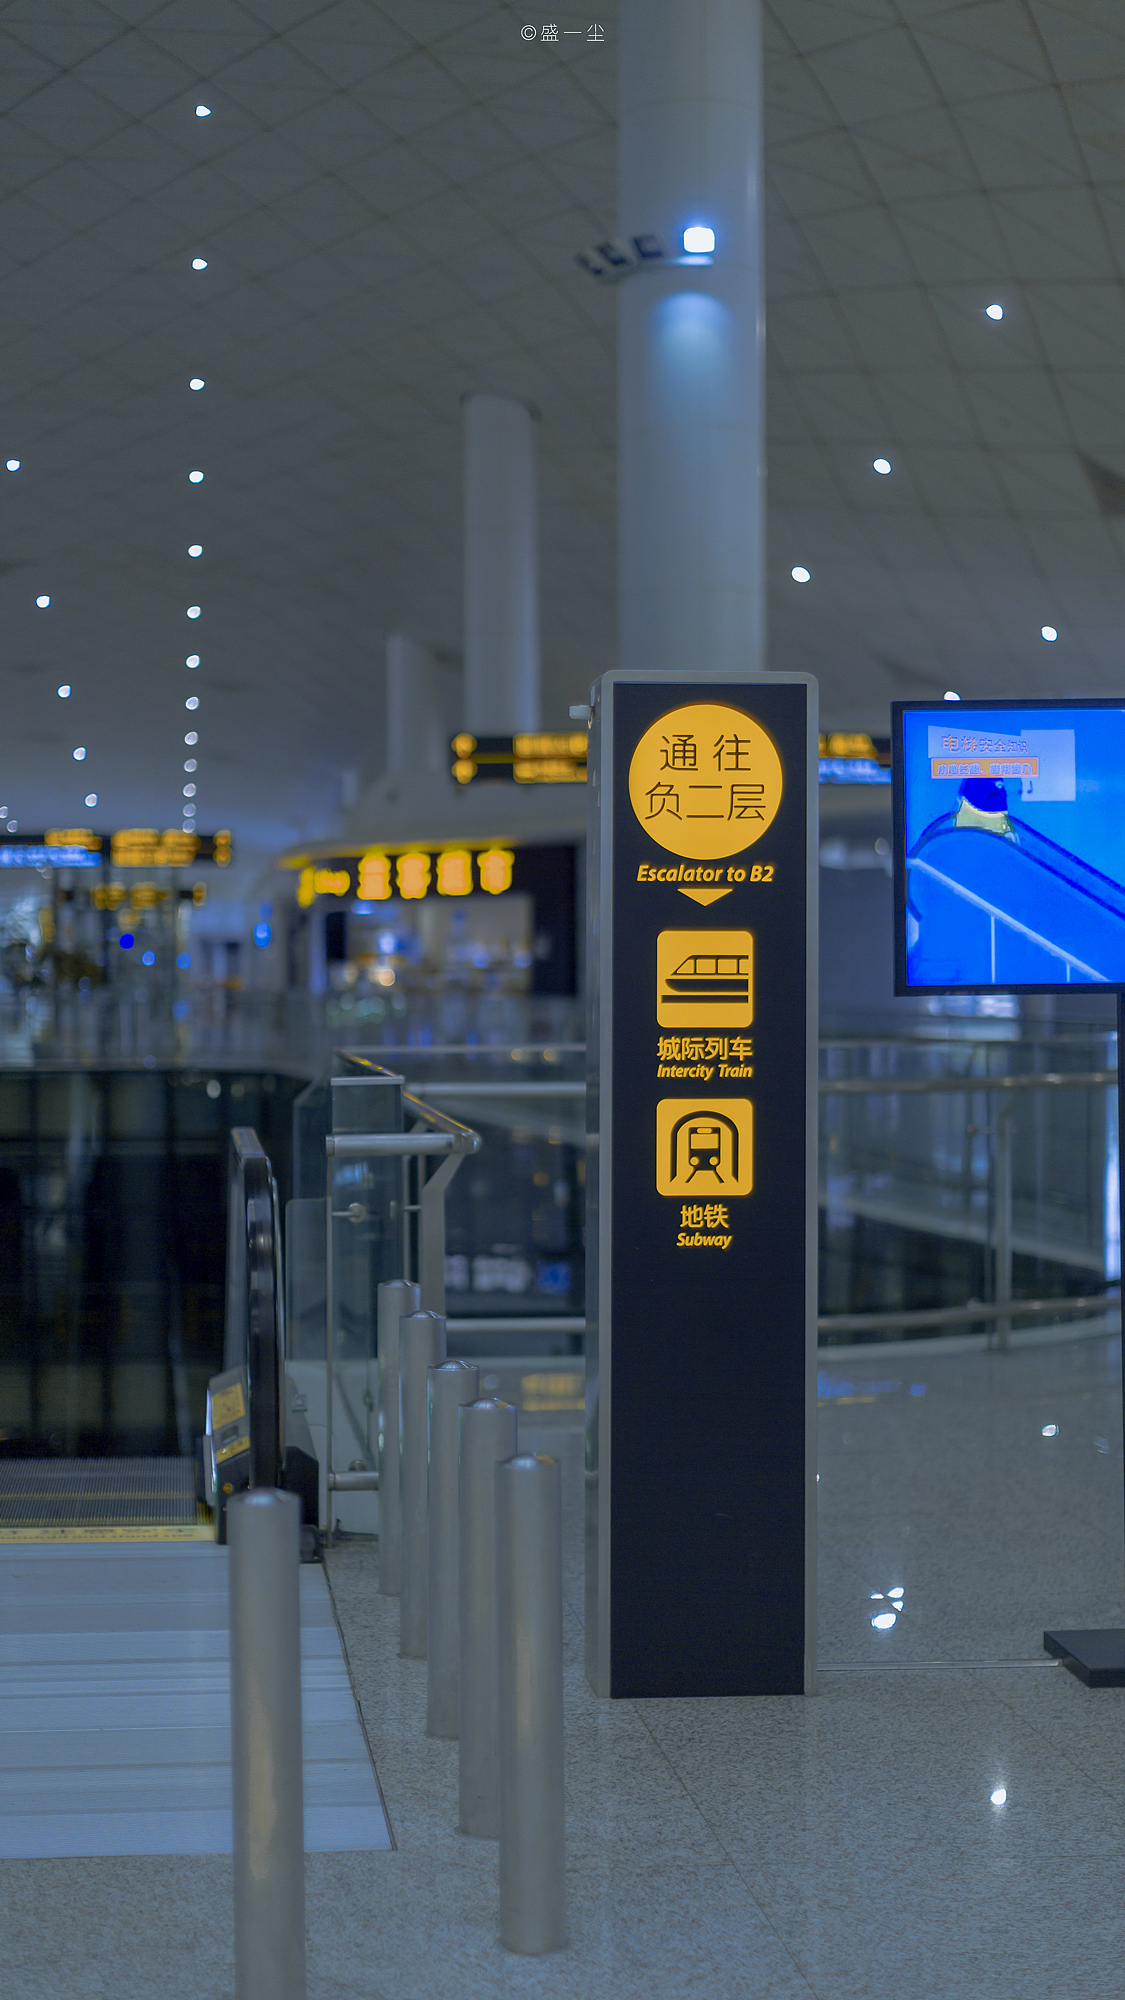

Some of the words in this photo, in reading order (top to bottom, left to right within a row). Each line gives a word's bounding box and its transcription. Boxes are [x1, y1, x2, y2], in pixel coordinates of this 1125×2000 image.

[660, 734, 751, 772] 通往
[941, 734, 1028, 753] 电梯安全知识
[645, 781, 766, 821] 负二层
[636, 864, 723, 882] Escalator
[726, 867, 746, 882] to
[749, 865, 774, 882] B2
[656, 1036, 753, 1061] 城际列车
[656, 1064, 714, 1081] Intercity
[718, 1064, 753, 1078] Train
[680, 1204, 729, 1228] 地铁
[676, 1232, 733, 1250] Subway
